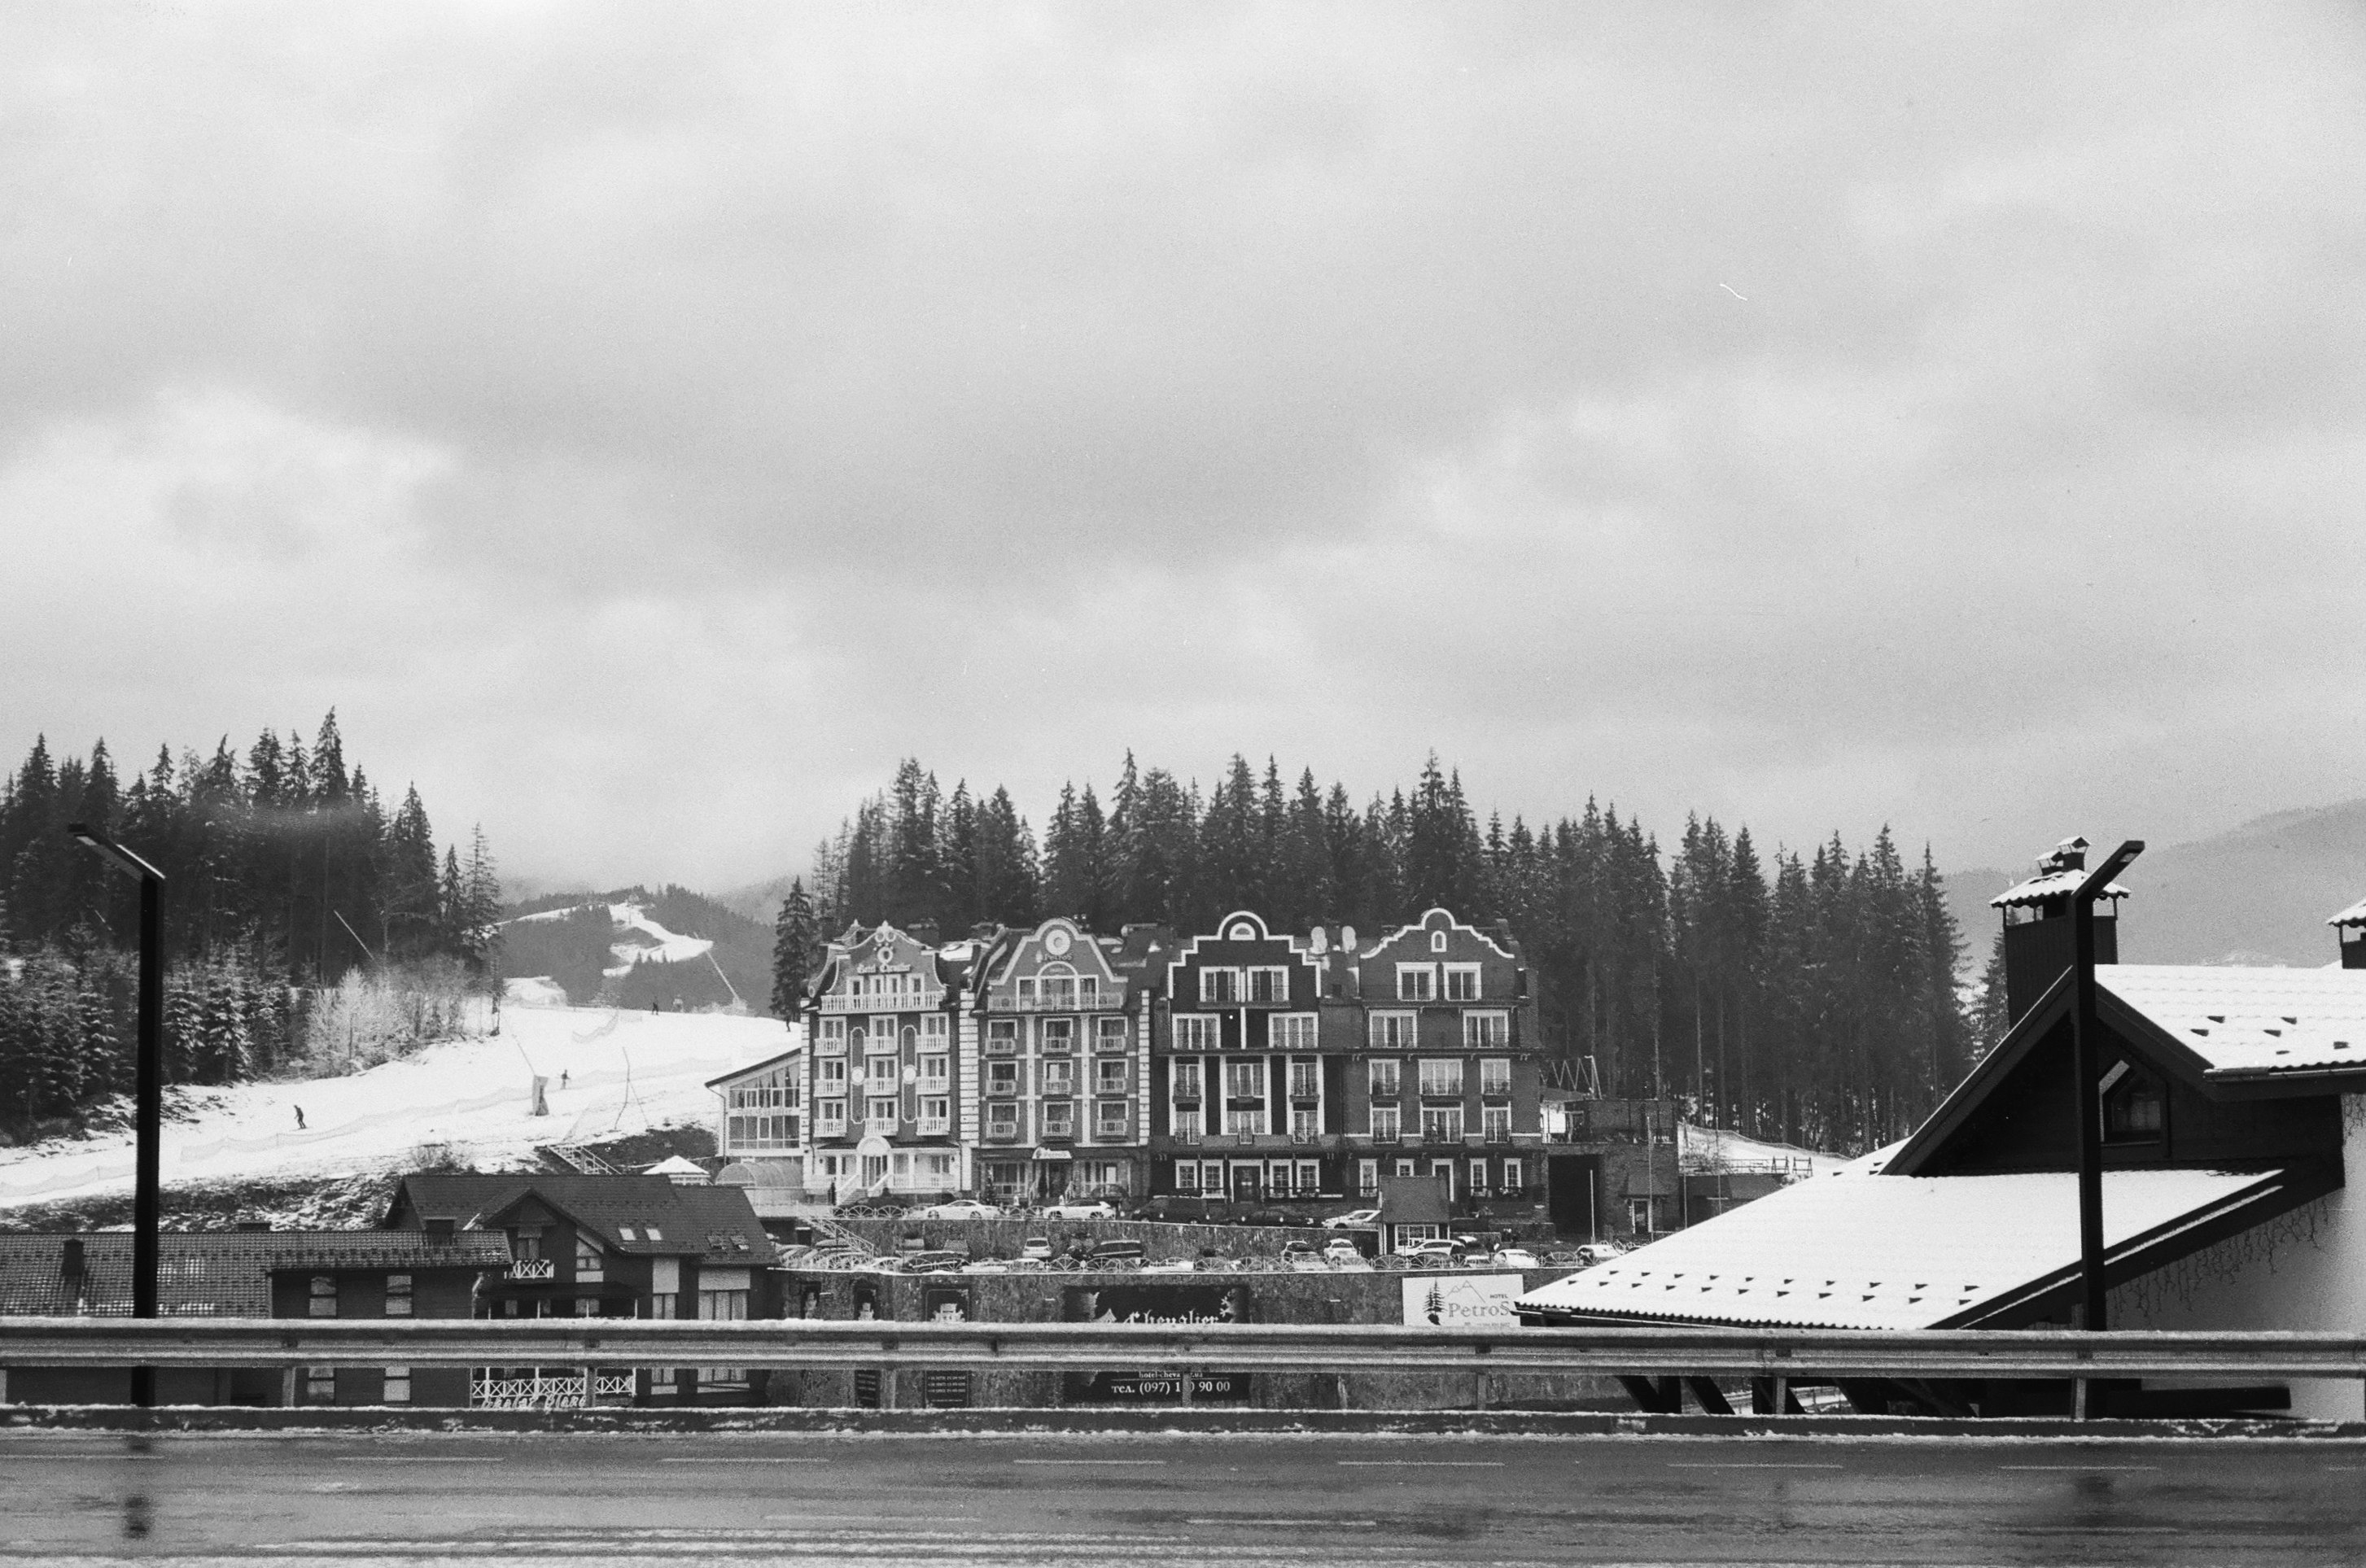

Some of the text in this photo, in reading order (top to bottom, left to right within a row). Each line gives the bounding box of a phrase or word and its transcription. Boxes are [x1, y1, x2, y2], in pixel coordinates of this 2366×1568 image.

[1139, 1381, 1170, 1395] (097)
[1175, 1381, 1195, 1392] 10
[1199, 1381, 1213, 1392] 90
[1217, 1381, 1230, 1392] 00
